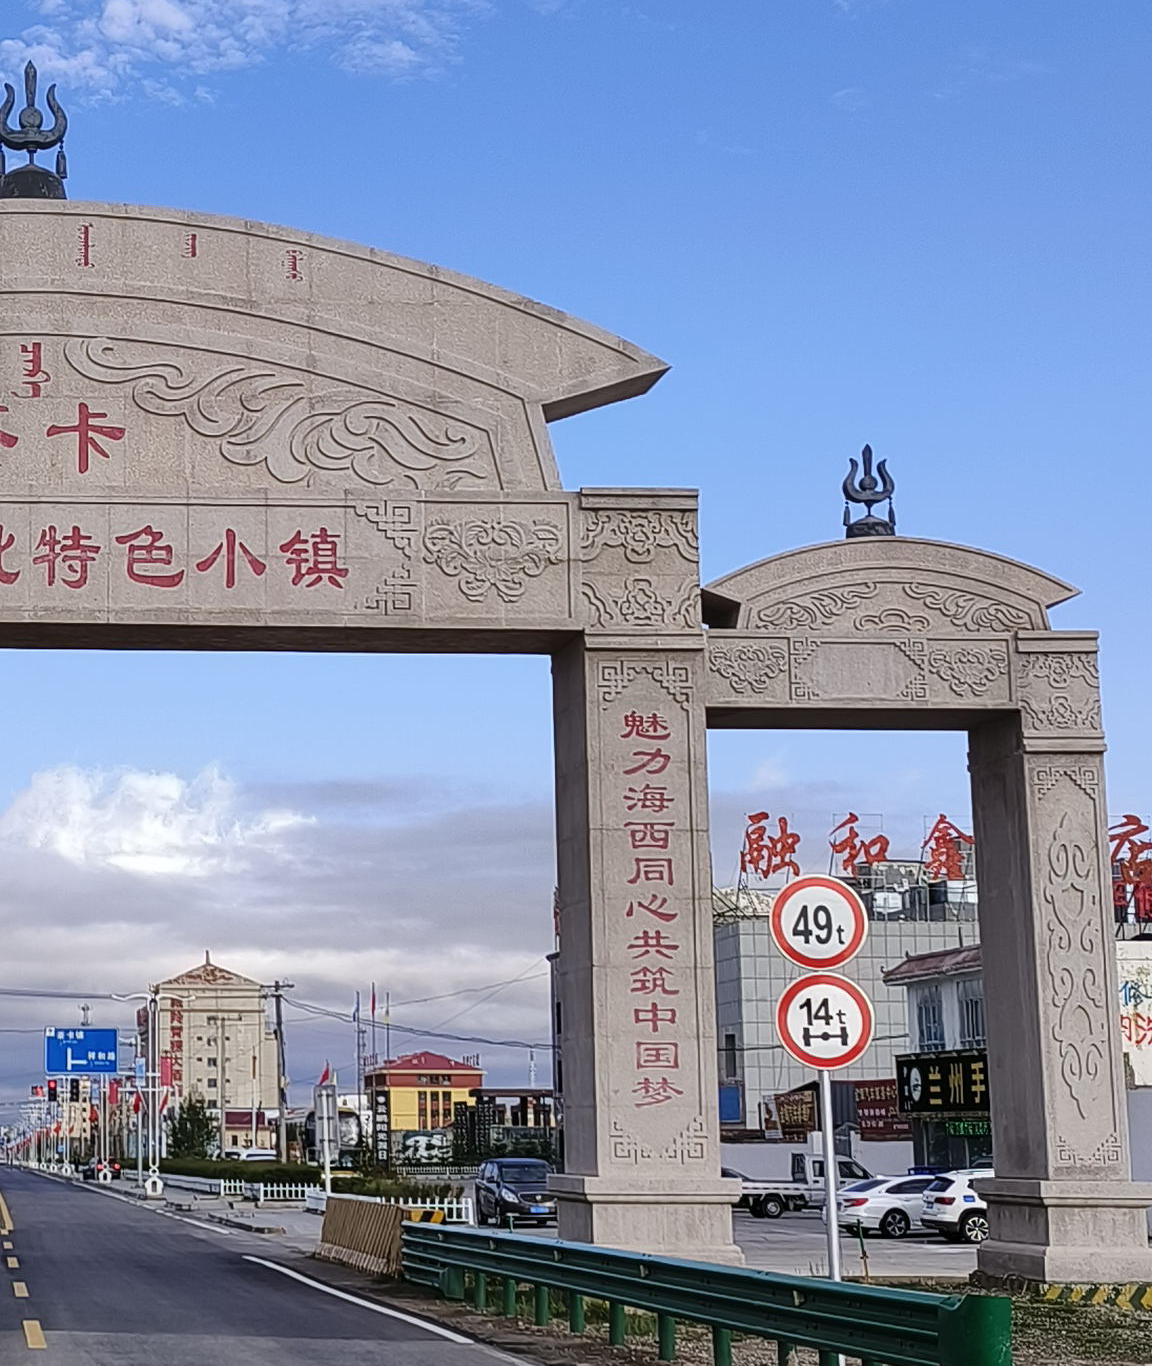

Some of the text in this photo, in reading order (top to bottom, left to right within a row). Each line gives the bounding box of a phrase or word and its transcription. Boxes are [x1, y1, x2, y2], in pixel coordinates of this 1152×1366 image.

[620, 709, 684, 1108] 魅力海西同心共筑中国梦
